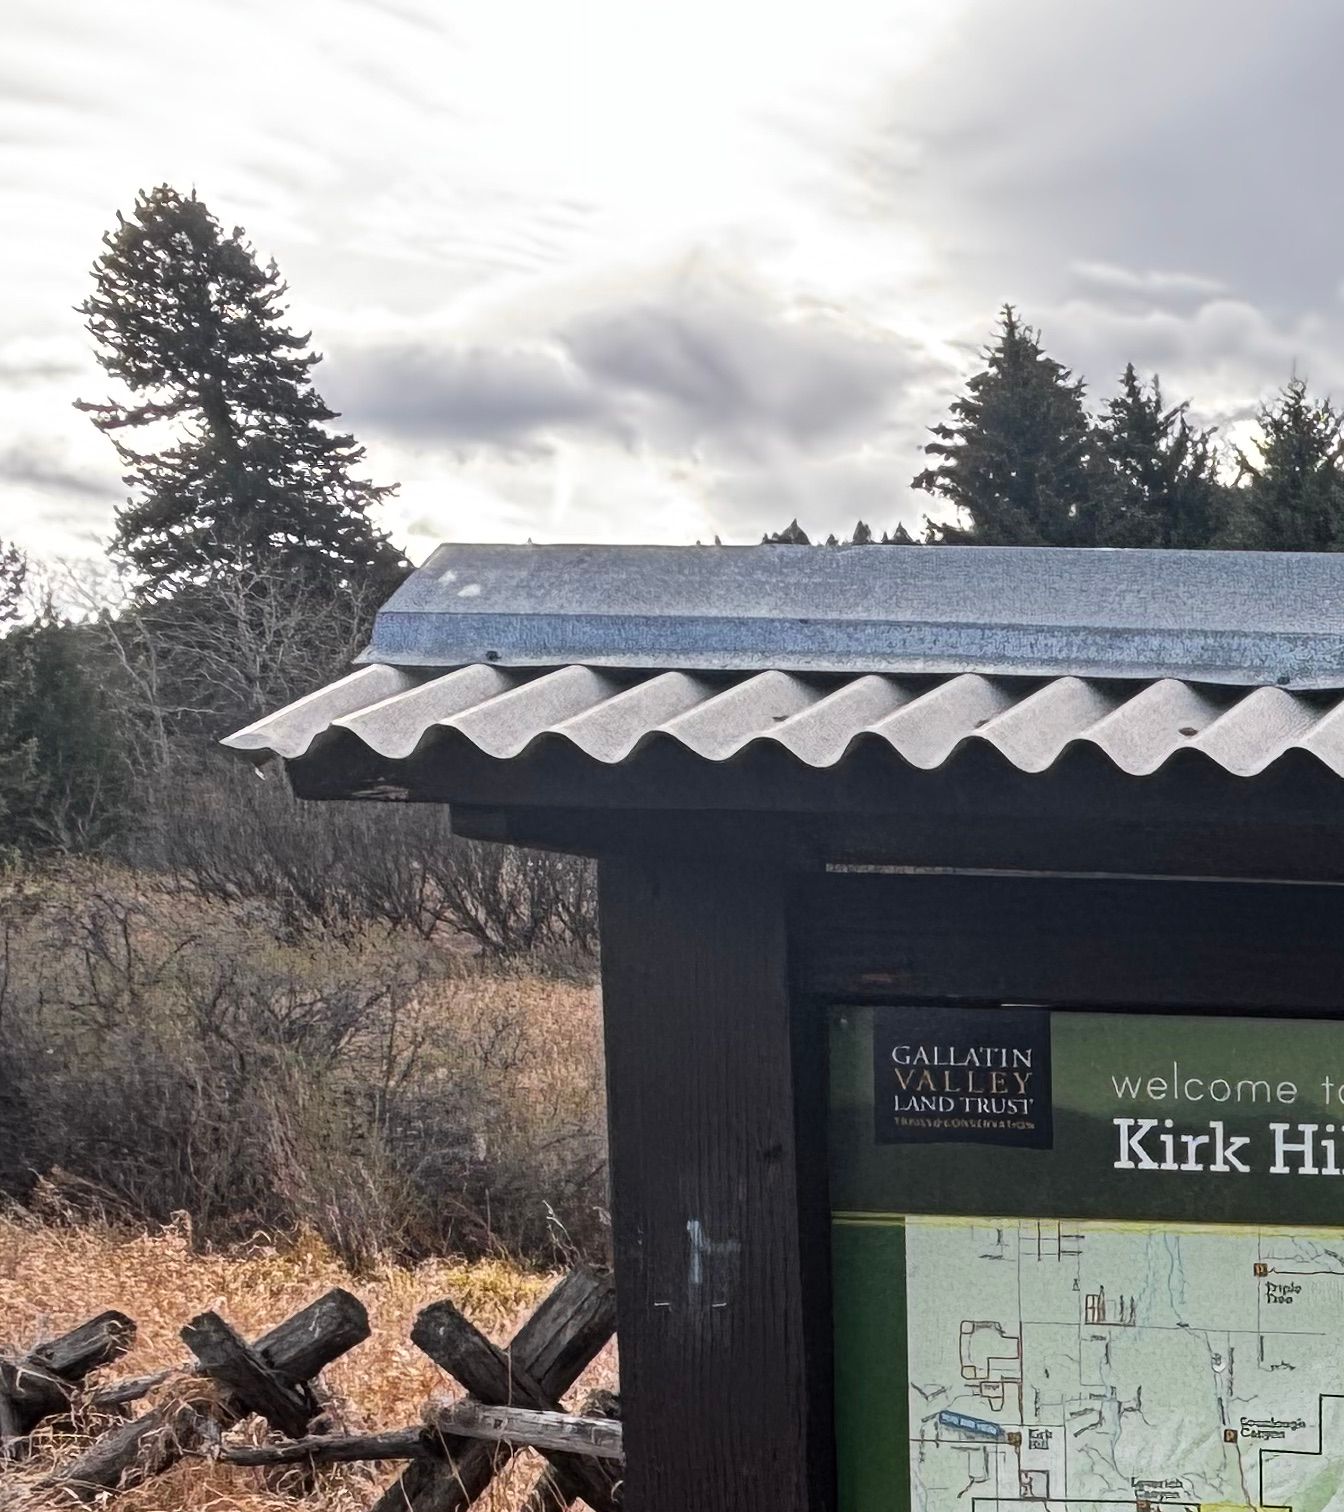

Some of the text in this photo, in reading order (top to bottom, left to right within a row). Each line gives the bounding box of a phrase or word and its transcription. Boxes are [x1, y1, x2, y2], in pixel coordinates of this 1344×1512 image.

[892, 1046, 1032, 1068] GALLATIN
[895, 1068, 1032, 1094] VALLEY
[1112, 1061, 1298, 1103] welcome
[894, 1095, 1034, 1114] LAND TRUST
[1113, 1118, 1250, 1172] Kirk
